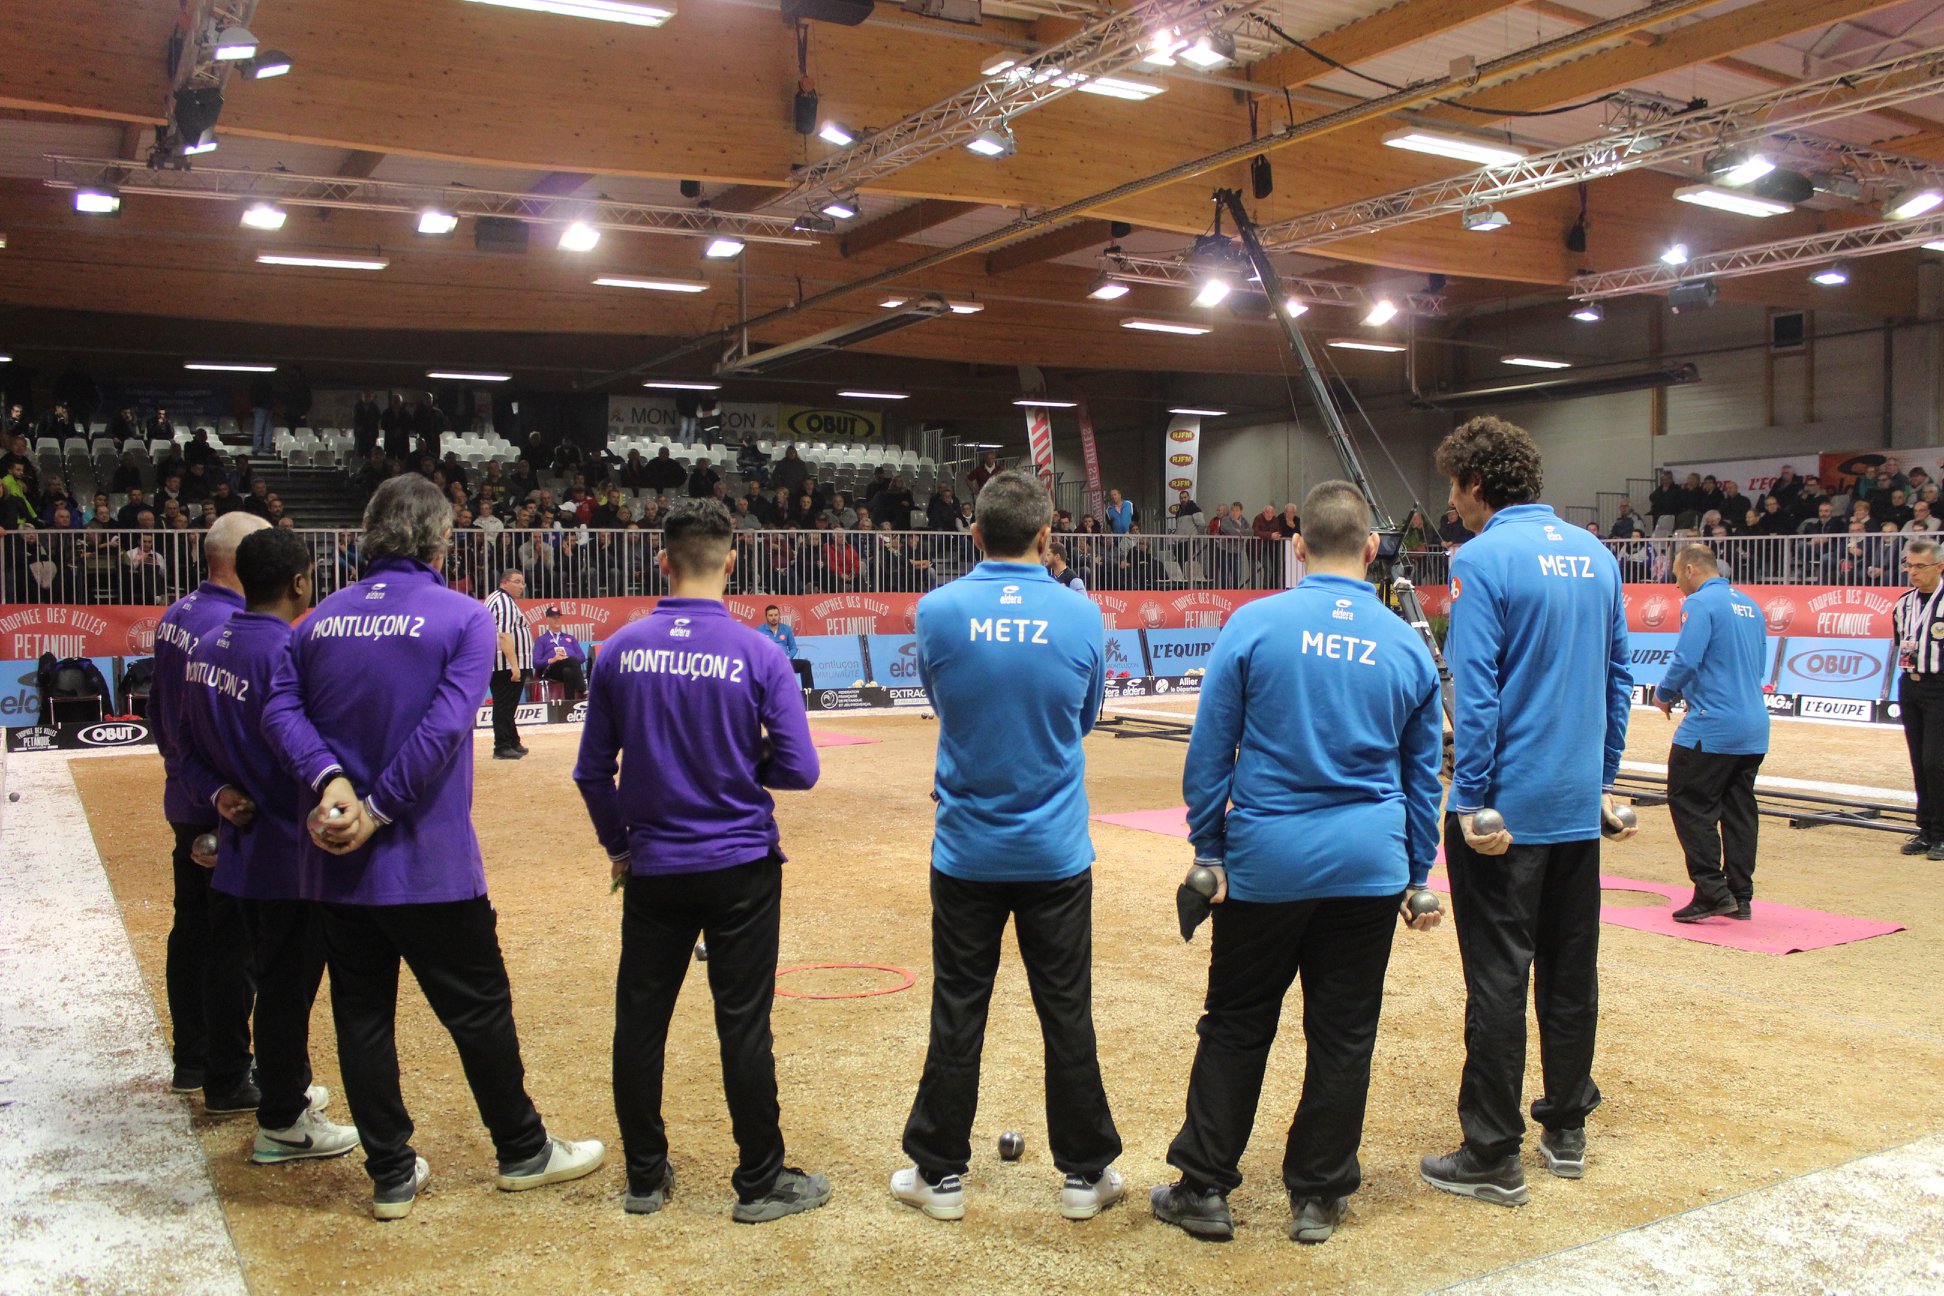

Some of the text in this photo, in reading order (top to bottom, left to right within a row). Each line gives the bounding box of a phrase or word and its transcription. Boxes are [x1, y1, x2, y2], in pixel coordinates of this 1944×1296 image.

[806, 414, 858, 434] OBUT
[1172, 431, 1193, 439] RJFM
[1537, 554, 1596, 578] METZ
[560, 601, 577, 615] DES
[580, 603, 610, 624] VILLES
[728, 599, 756, 620] VILLES
[810, 596, 843, 621] TROPHEE
[845, 595, 861, 609] DES
[863, 597, 890, 617] VILLES
[1105, 594, 1128, 614] VILLES
[1198, 592, 1210, 605] DES
[1212, 592, 1232, 612] VILLES
[1807, 589, 1843, 613] TROPHEE
[1845, 589, 1862, 605] DES
[1863, 590, 1893, 615] VILLES
[46, 607, 67, 624] DES
[71, 609, 108, 636] VILLES
[310, 614, 426, 641] MONTLUÇON 2
[970, 617, 1049, 645] METZ
[1816, 612, 1874, 637] PETANQUE
[187, 636, 199, 656] 2
[1152, 642, 1216, 659] L'ÉQUIP
[1301, 629, 1377, 666] METZ
[619, 648, 745, 684] MONTLUÇON 2
[1806, 653, 1864, 676] OBUT
[236, 679, 250, 702] 2
[1122, 685, 1146, 697] eldera
[1179, 677, 1199, 686] Allier
[92, 726, 135, 742] OBUT
